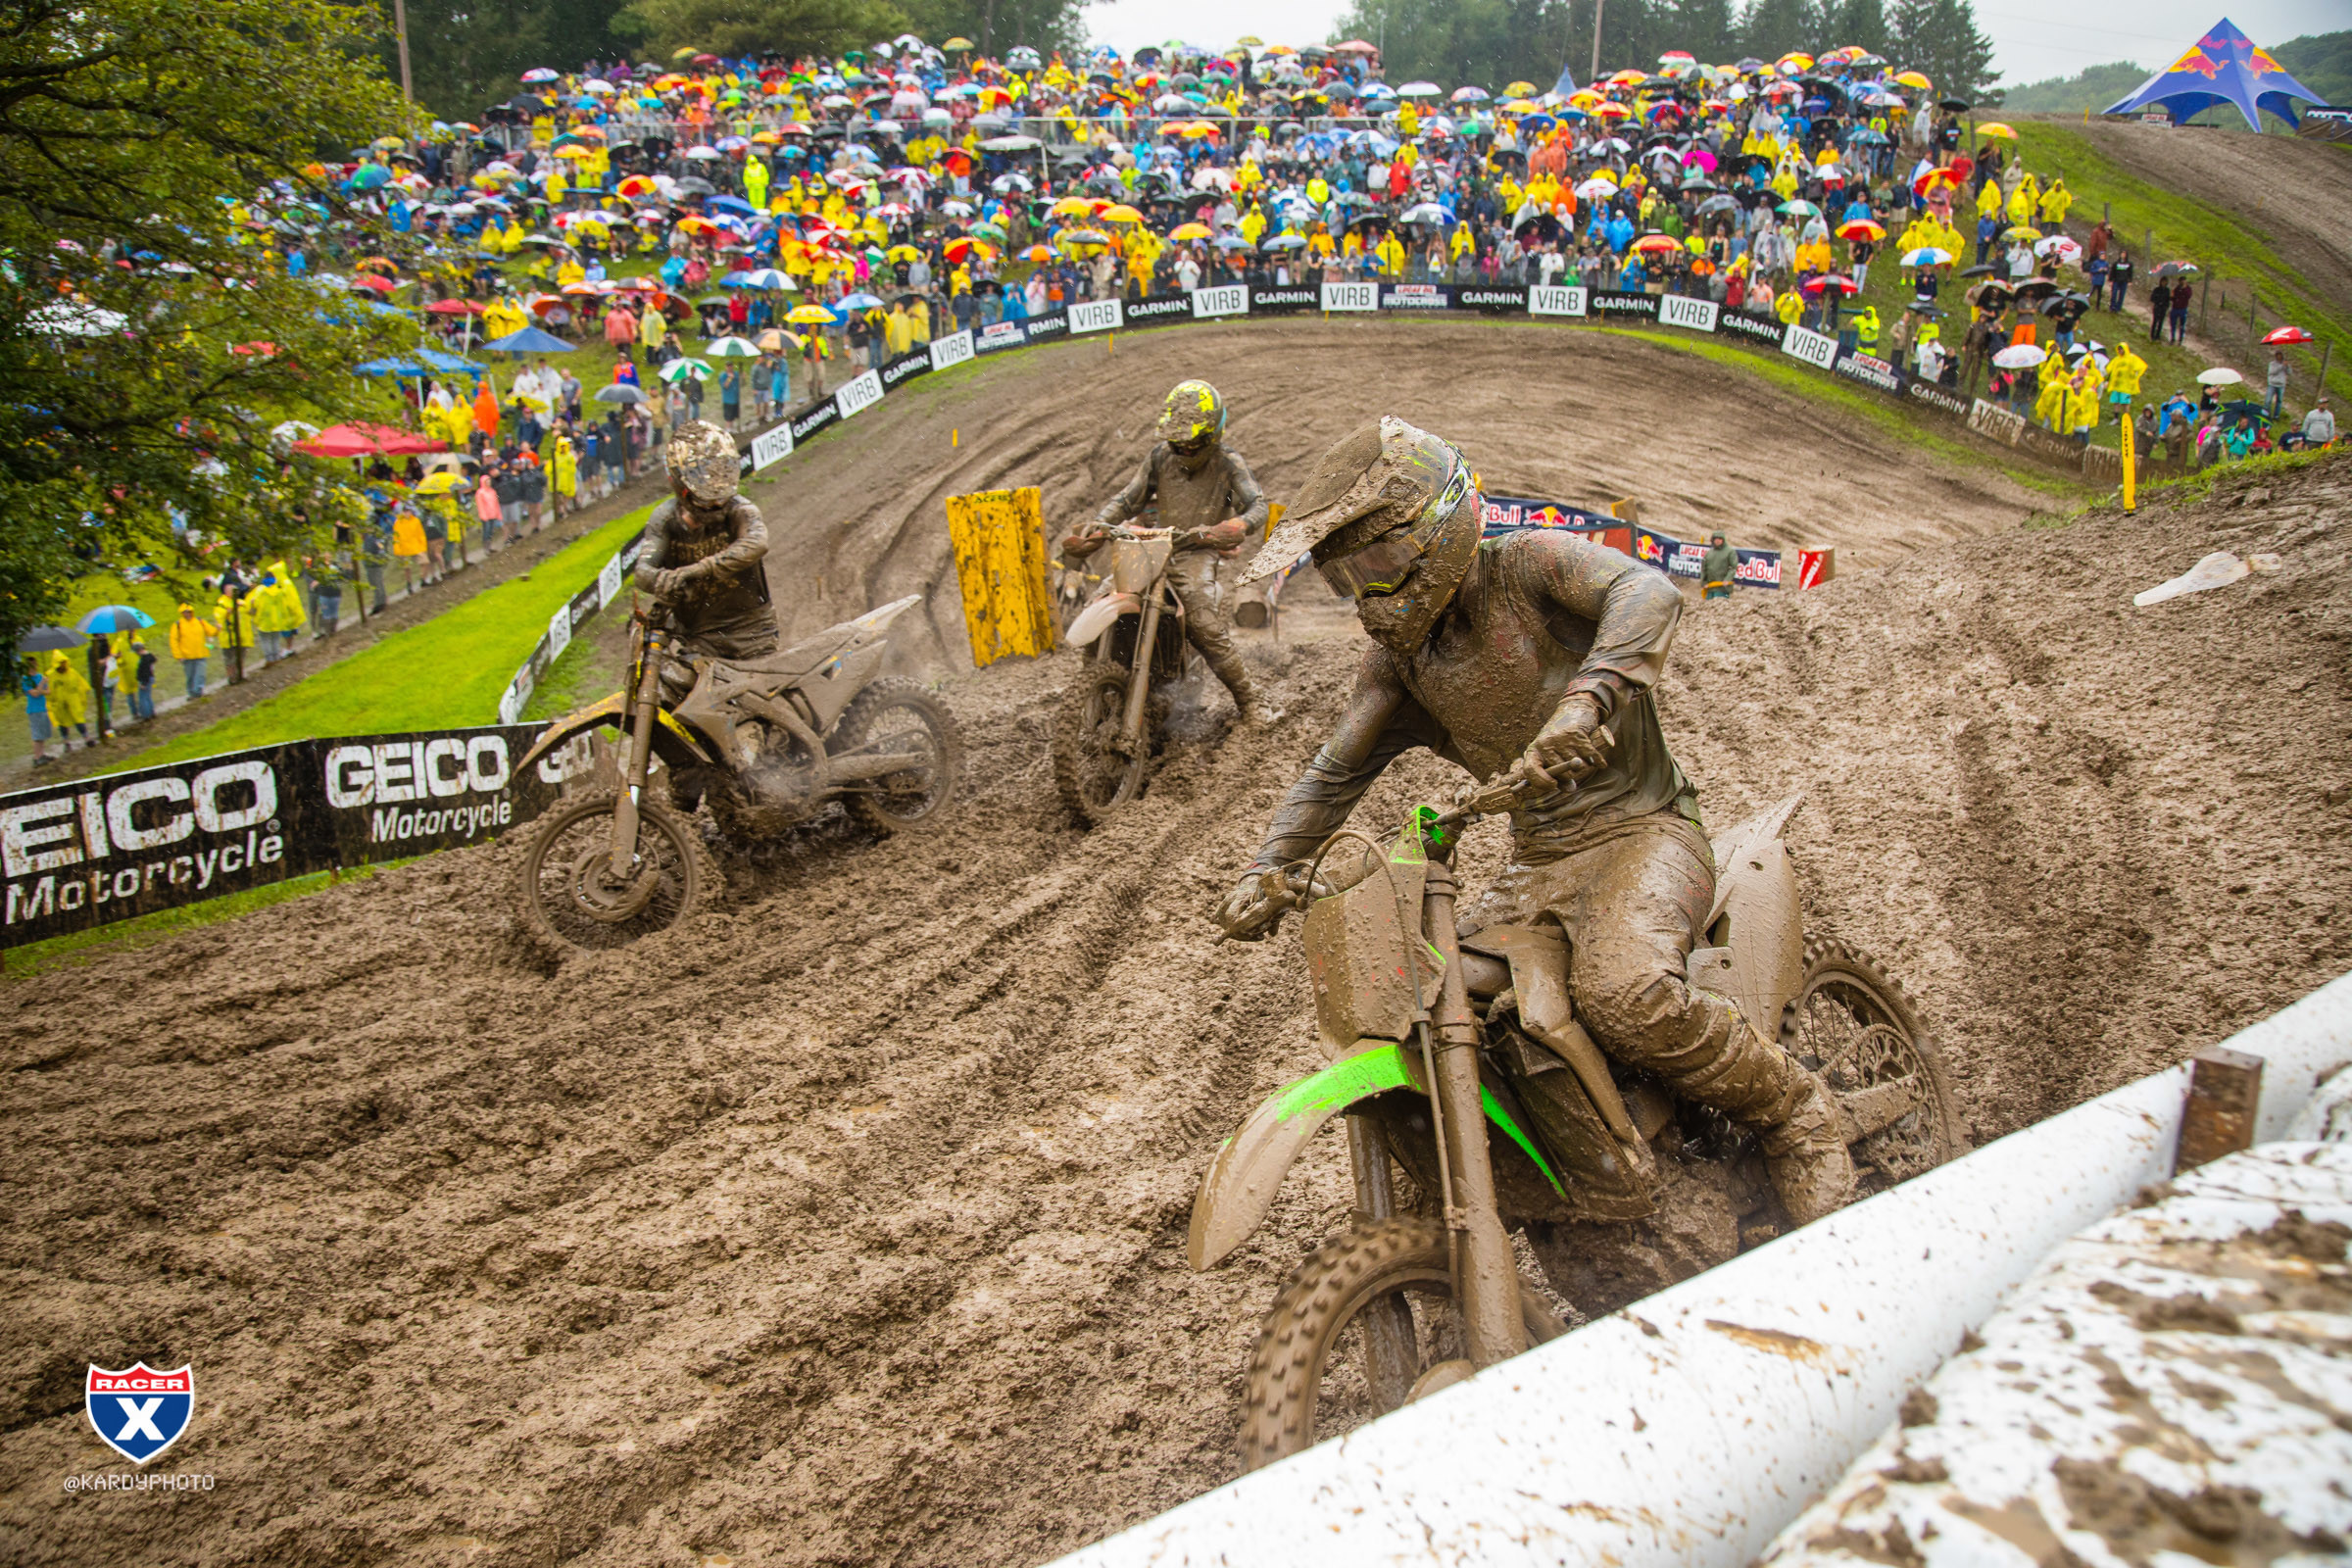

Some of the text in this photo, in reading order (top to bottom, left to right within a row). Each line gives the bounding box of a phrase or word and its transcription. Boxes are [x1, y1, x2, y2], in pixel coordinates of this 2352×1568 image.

[1128, 299, 1189, 317] GARMIN
[1200, 289, 1242, 313] VIRB
[1254, 291, 1317, 305] GARMIN
[1329, 287, 1370, 306] VIRB
[1461, 292, 1524, 305] GARMIN
[1537, 289, 1579, 311] VIRB
[1592, 297, 1655, 313] GARMIN
[1076, 304, 1115, 328] VIRB
[1669, 300, 1710, 324] VIRB
[1028, 317, 1066, 335] RMIN
[1723, 314, 1781, 340] GARMIN
[936, 336, 969, 364] VIRB
[1791, 329, 1830, 362] VIRB
[883, 353, 930, 384] GARMIN
[842, 376, 878, 411] VIRB
[1910, 382, 1966, 415] GARMIN
[793, 403, 838, 438] GARMIN
[757, 430, 789, 463] VIRB
[1489, 504, 1521, 526] Bull
[1735, 557, 1753, 579] ed
[1753, 560, 1782, 583] Bull
[325, 735, 511, 808] GEICO
[0, 760, 278, 878] EICO
[371, 794, 512, 843] Motorcycle
[5, 830, 284, 925] Motorcycle
